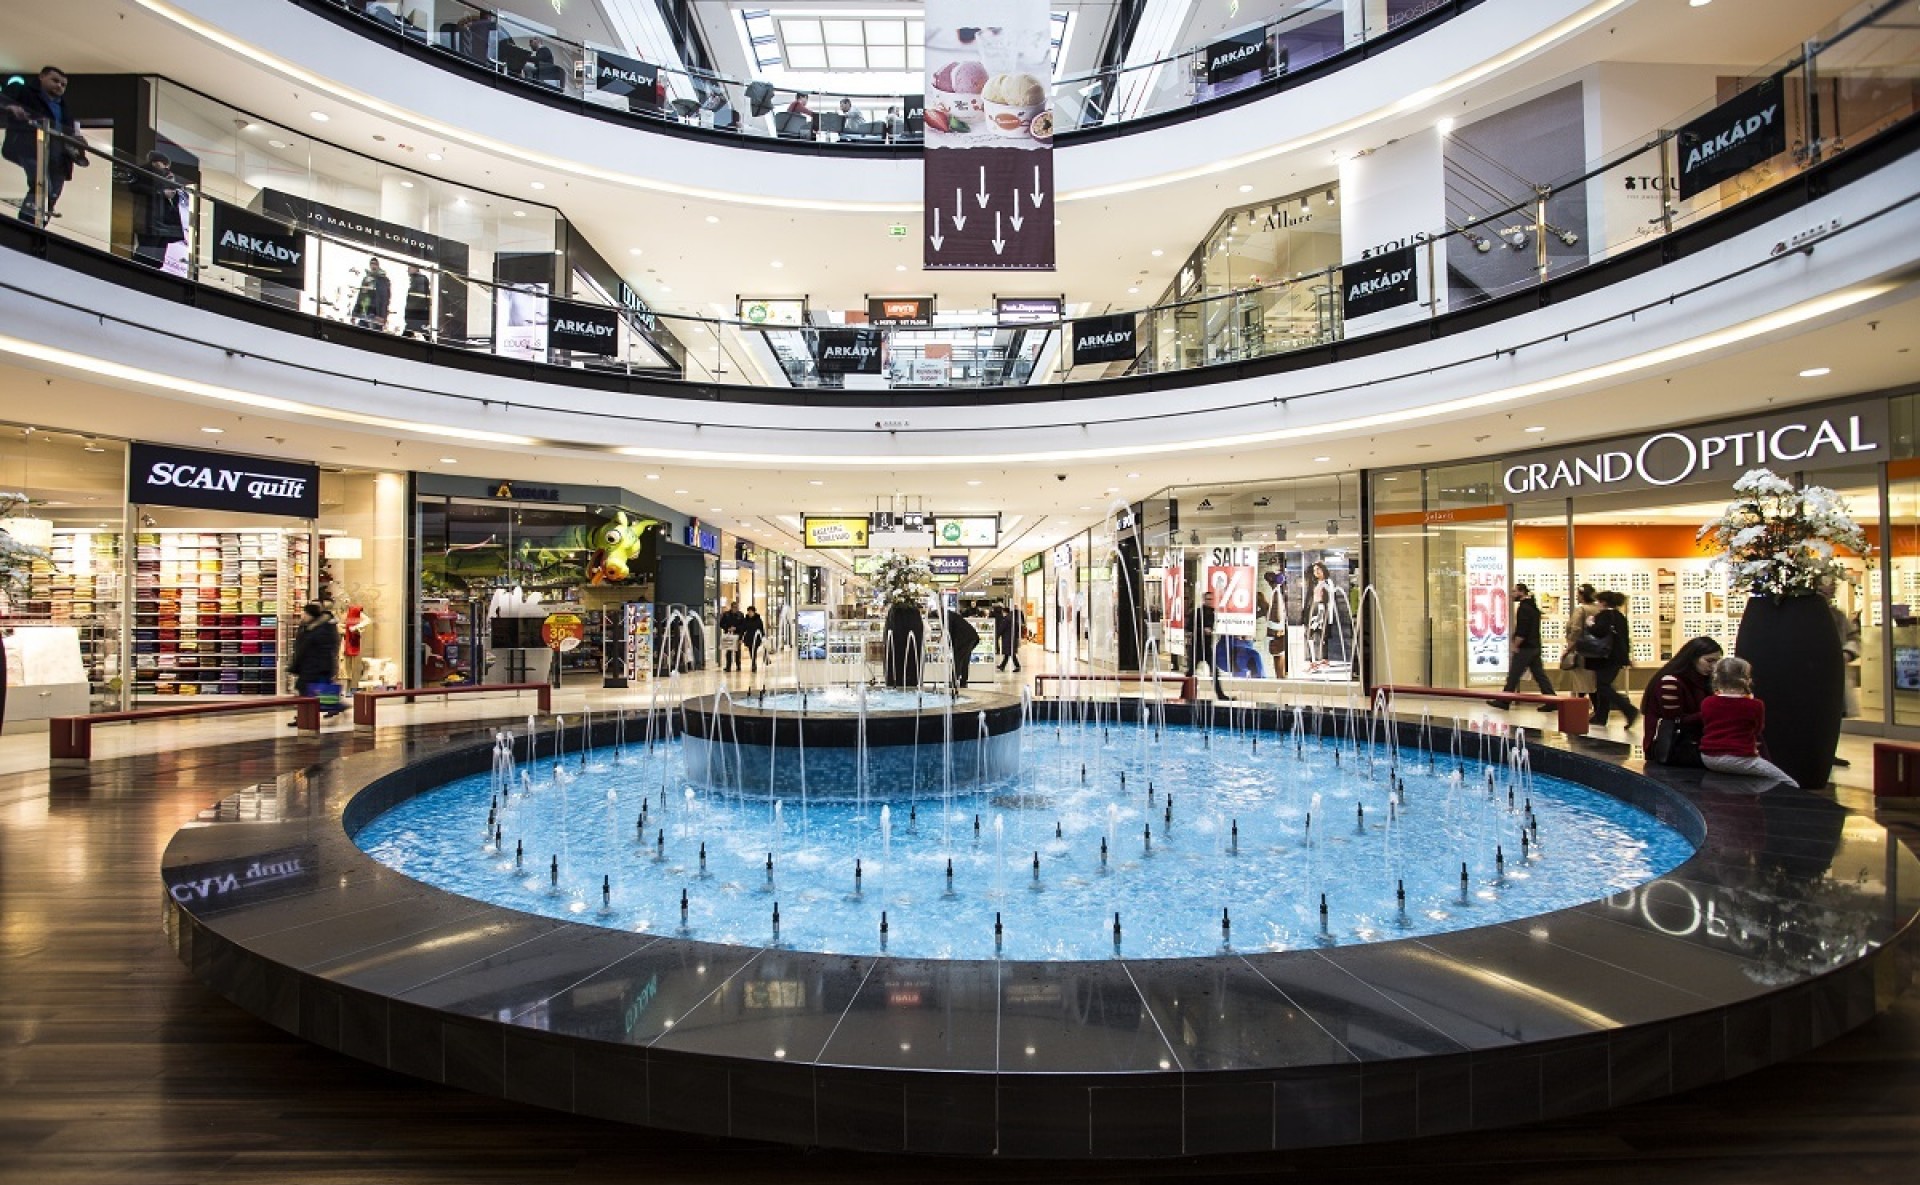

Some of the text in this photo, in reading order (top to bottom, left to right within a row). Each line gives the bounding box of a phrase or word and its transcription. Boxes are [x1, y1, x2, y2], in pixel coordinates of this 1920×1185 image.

[1211, 42, 1263, 71] ARKÁDY
[602, 66, 654, 87] ARKÁDY
[1685, 104, 1777, 174] ARKÁDY
[308, 212, 435, 251] JO MALONE LONDON
[1262, 211, 1313, 232] Allure
[220, 229, 301, 265] ARKÁDY
[1348, 268, 1412, 301] ARKÁDY
[554, 318, 615, 338] ARKÁDY
[1076, 330, 1132, 351] ARKÁDY
[823, 343, 878, 359] ARKÁDY
[147, 461, 305, 499] SCAN quilt
[1212, 546, 1251, 567] SALE
[1469, 572, 1504, 586] SLEVY
[1469, 588, 1507, 638] 50
